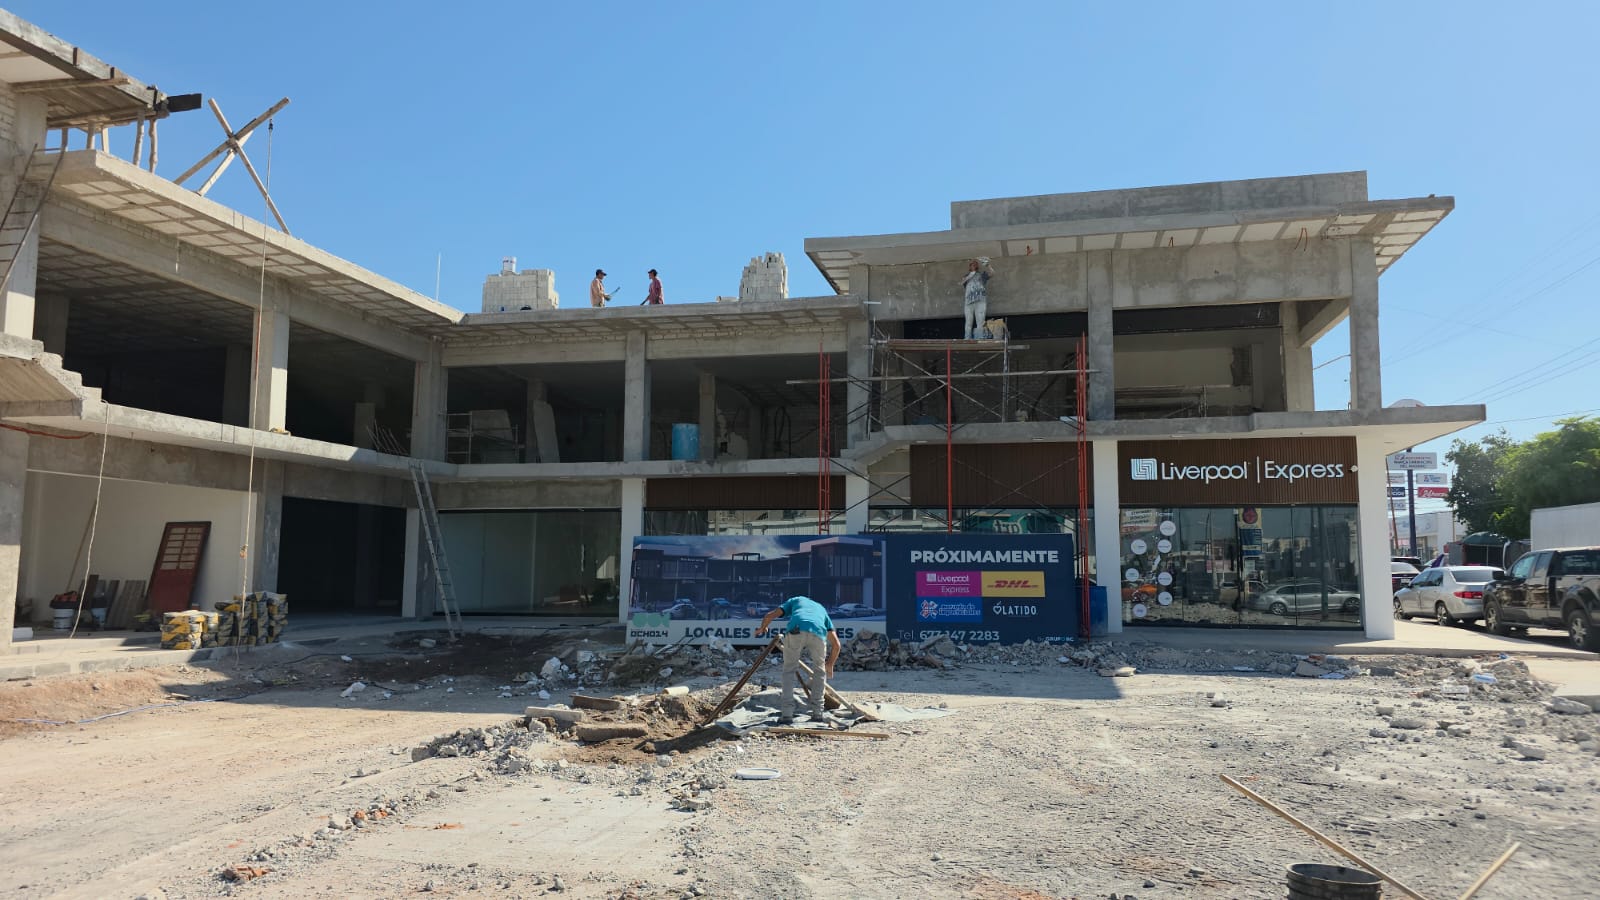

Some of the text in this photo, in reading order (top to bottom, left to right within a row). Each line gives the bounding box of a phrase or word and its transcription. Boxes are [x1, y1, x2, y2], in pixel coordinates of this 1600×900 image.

[1161, 460, 1344, 484] Liverpool Express
[910, 547, 1060, 563] PRÓXIMAMENTE
[937, 575, 969, 584] Liverpool
[994, 580, 1033, 588] DHL
[941, 586, 970, 594] Express
[684, 627, 751, 638] LOCALES
[969, 630, 1000, 640] 2283
